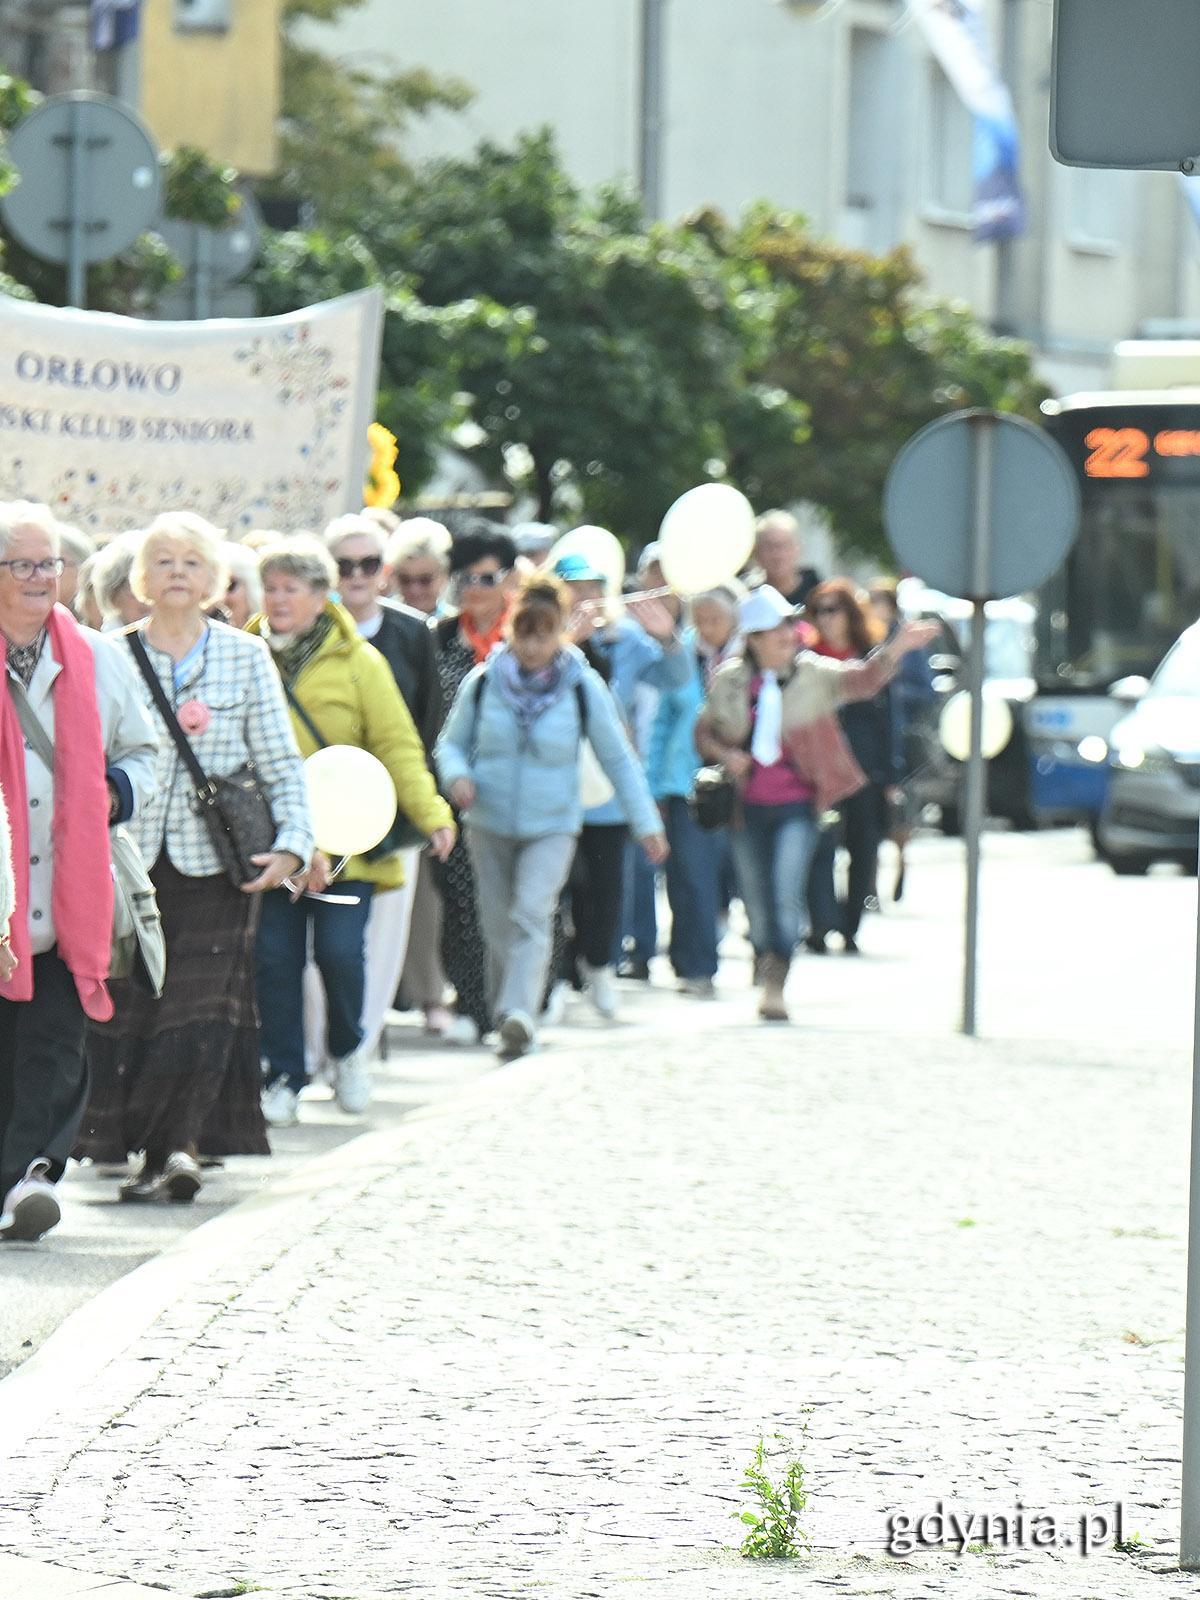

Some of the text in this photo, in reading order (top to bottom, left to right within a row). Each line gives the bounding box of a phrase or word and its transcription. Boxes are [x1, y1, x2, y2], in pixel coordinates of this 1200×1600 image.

[16, 350, 181, 395] ORŁOWO
[59, 410, 136, 441] KLUB
[141, 416, 255, 445] SENIORA
[1084, 427, 1150, 478] 22
